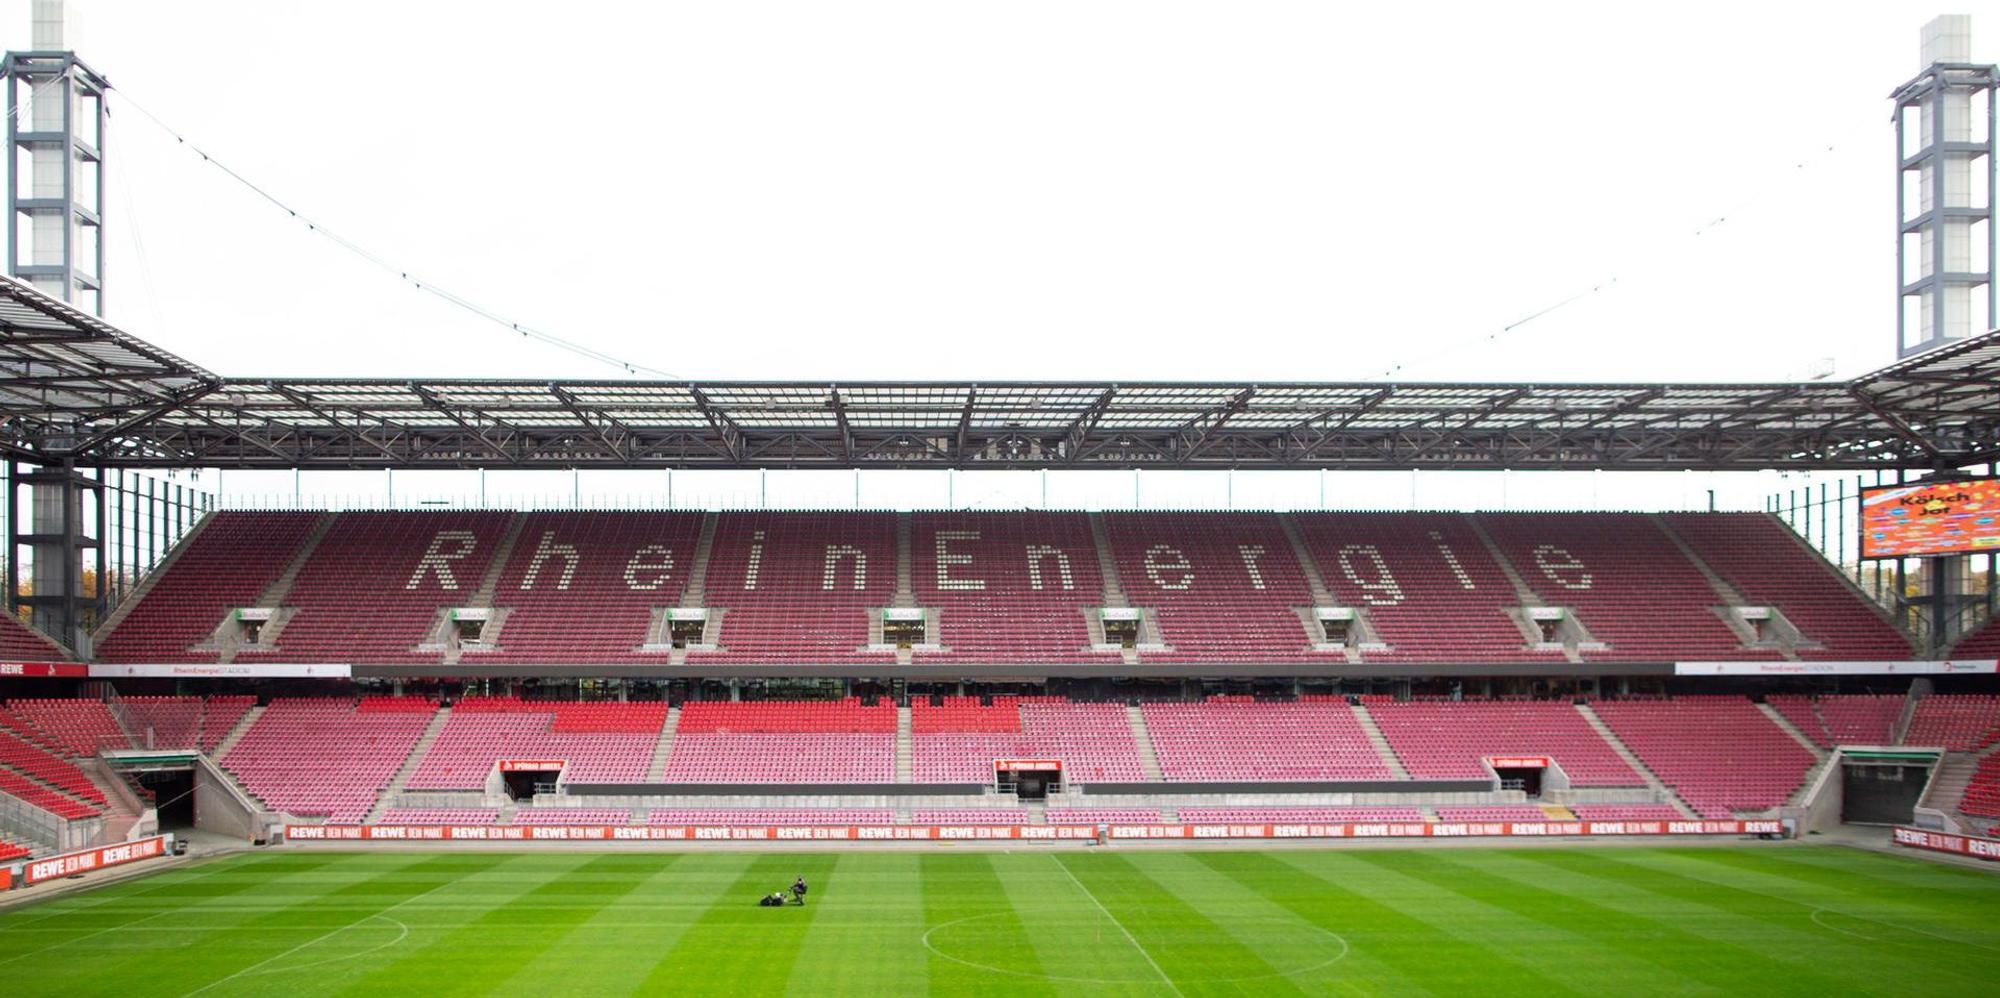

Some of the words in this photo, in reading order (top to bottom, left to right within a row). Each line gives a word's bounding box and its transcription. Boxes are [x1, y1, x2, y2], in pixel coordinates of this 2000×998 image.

[1, 664, 23, 675] REWE
[1113, 827, 1147, 837] REWE
[1194, 826, 1228, 837] REWE
[1274, 826, 1308, 836] REWE
[1354, 825, 1388, 836] REWE
[1433, 825, 1467, 835] REWE
[1512, 824, 1546, 834] REWE
[1591, 823, 1624, 834] REWE
[1669, 823, 1703, 833] REWE
[1745, 822, 1778, 832] REWE
[290, 828, 324, 838] REWE
[371, 828, 405, 838] REWE
[452, 828, 486, 838] REWE
[533, 828, 567, 838] REWE
[614, 828, 648, 838] REWE
[696, 828, 730, 838] REWE
[777, 828, 811, 838] REWE
[858, 828, 892, 838] REWE
[940, 828, 974, 838] REWE
[1021, 827, 1056, 838] REWE
[1895, 829, 1928, 845] REWE
[103, 845, 131, 864] REWE
[32, 859, 64, 880] REWE
